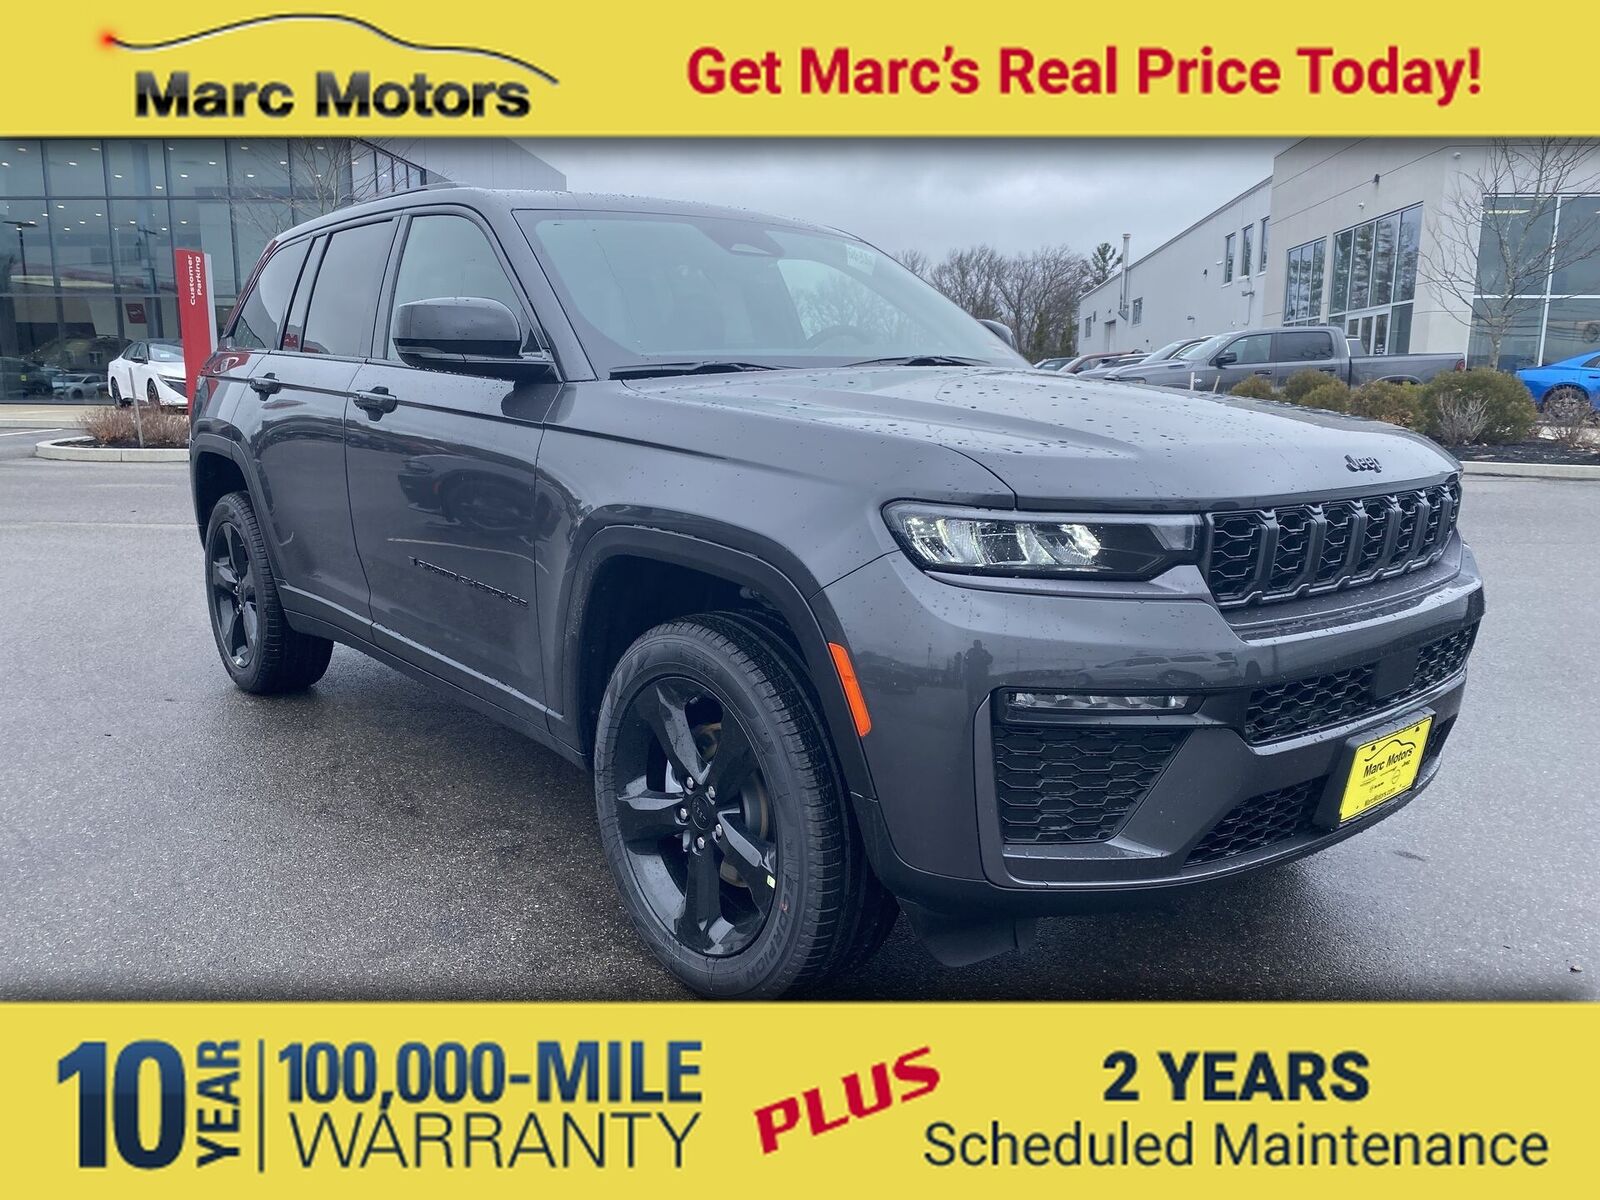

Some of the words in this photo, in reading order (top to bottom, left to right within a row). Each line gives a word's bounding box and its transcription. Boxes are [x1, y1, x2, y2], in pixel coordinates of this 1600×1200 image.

[187, 254, 196, 306] Customer
[195, 256, 203, 296] Parking
[1344, 454, 1382, 473] Jeep
[1363, 761, 1385, 778] Marc
[1386, 747, 1413, 767] Motors
